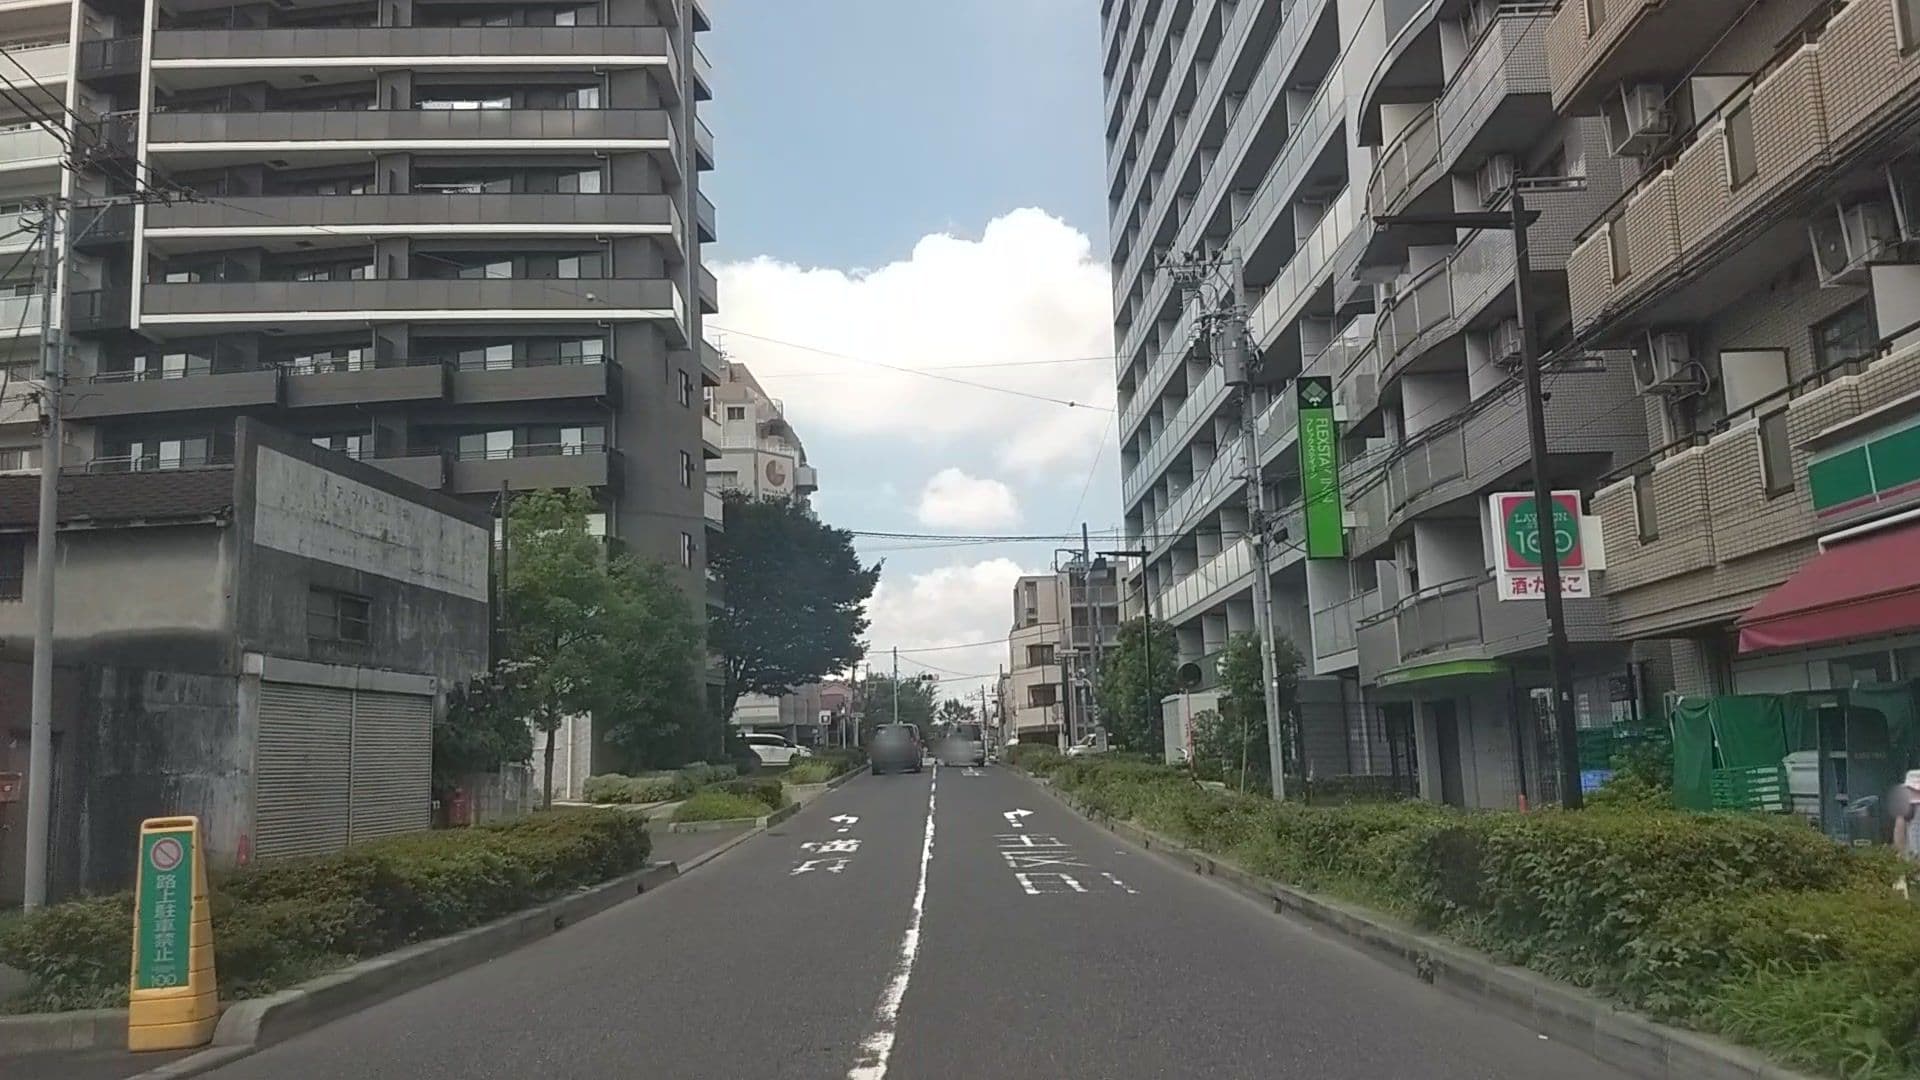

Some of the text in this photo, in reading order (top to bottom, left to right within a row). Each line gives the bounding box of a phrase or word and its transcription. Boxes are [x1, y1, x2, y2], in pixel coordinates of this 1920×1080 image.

[1316, 418, 1332, 474] FLEXSTAY
[1515, 512, 1568, 523] LAWON
[153, 874, 177, 962] 路上駐車禁止
